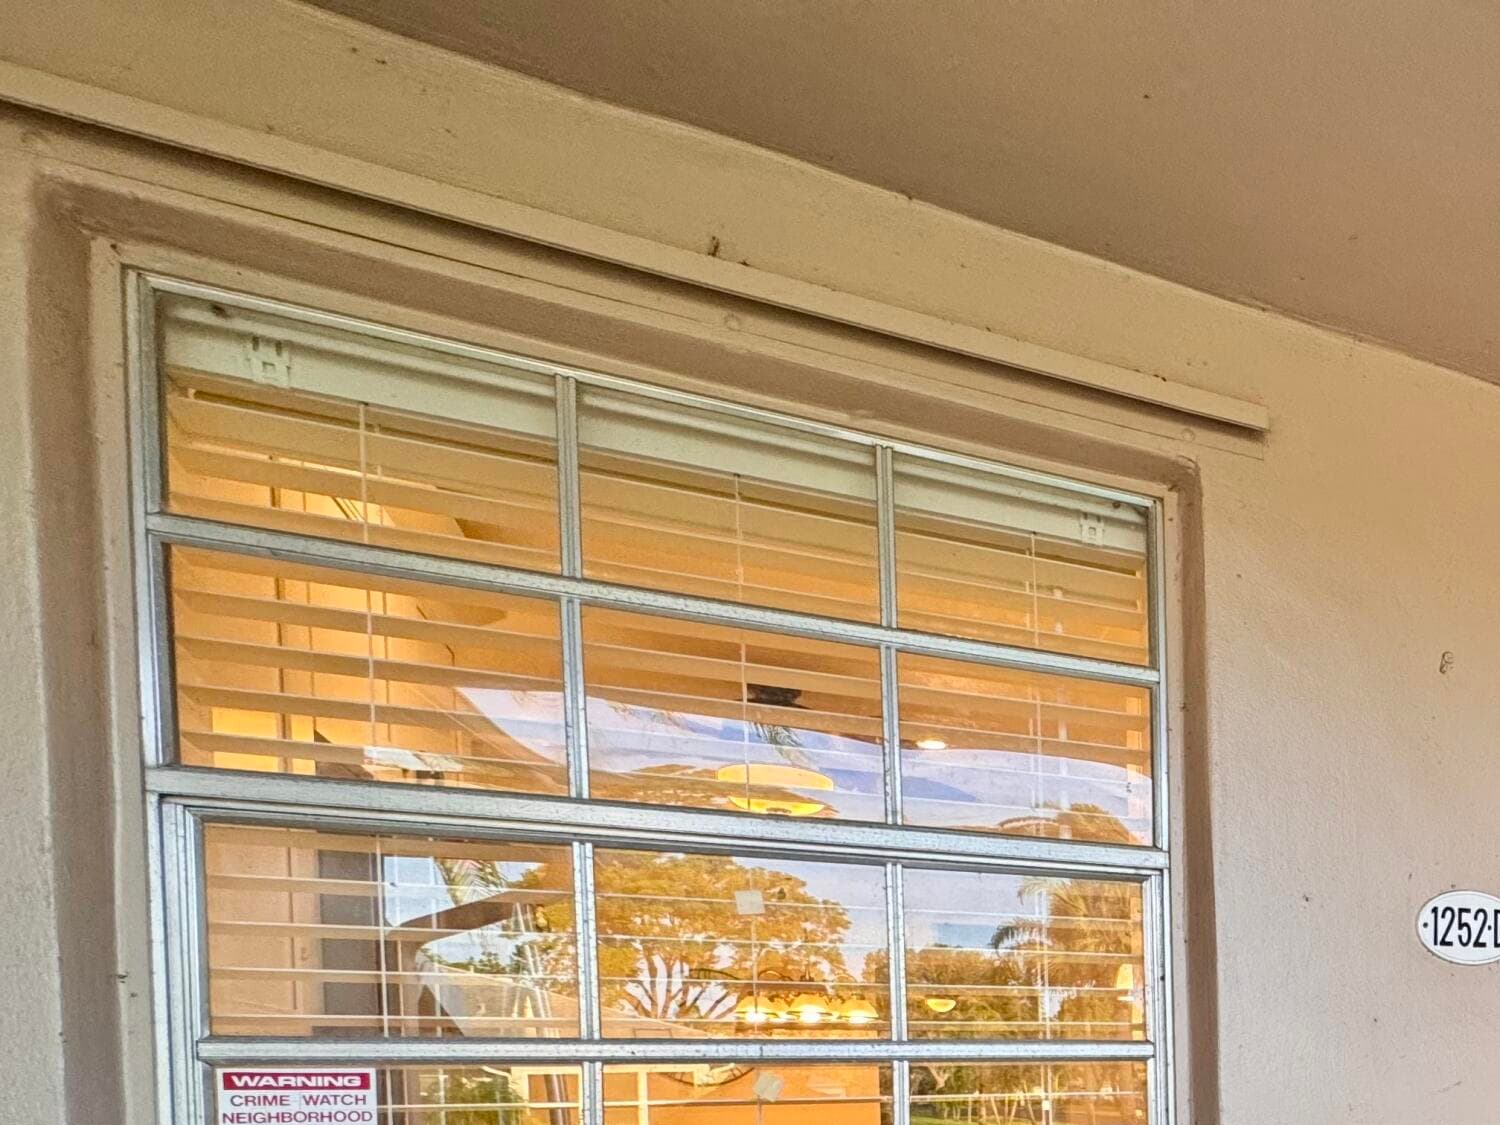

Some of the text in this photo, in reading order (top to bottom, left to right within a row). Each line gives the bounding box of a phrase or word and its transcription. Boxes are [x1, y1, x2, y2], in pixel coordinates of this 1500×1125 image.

[231, 1075, 361, 1087] WARNING
[230, 1095, 366, 1106] CRIME WATCH
[222, 1111, 373, 1124] NEIGHBORHOOD
